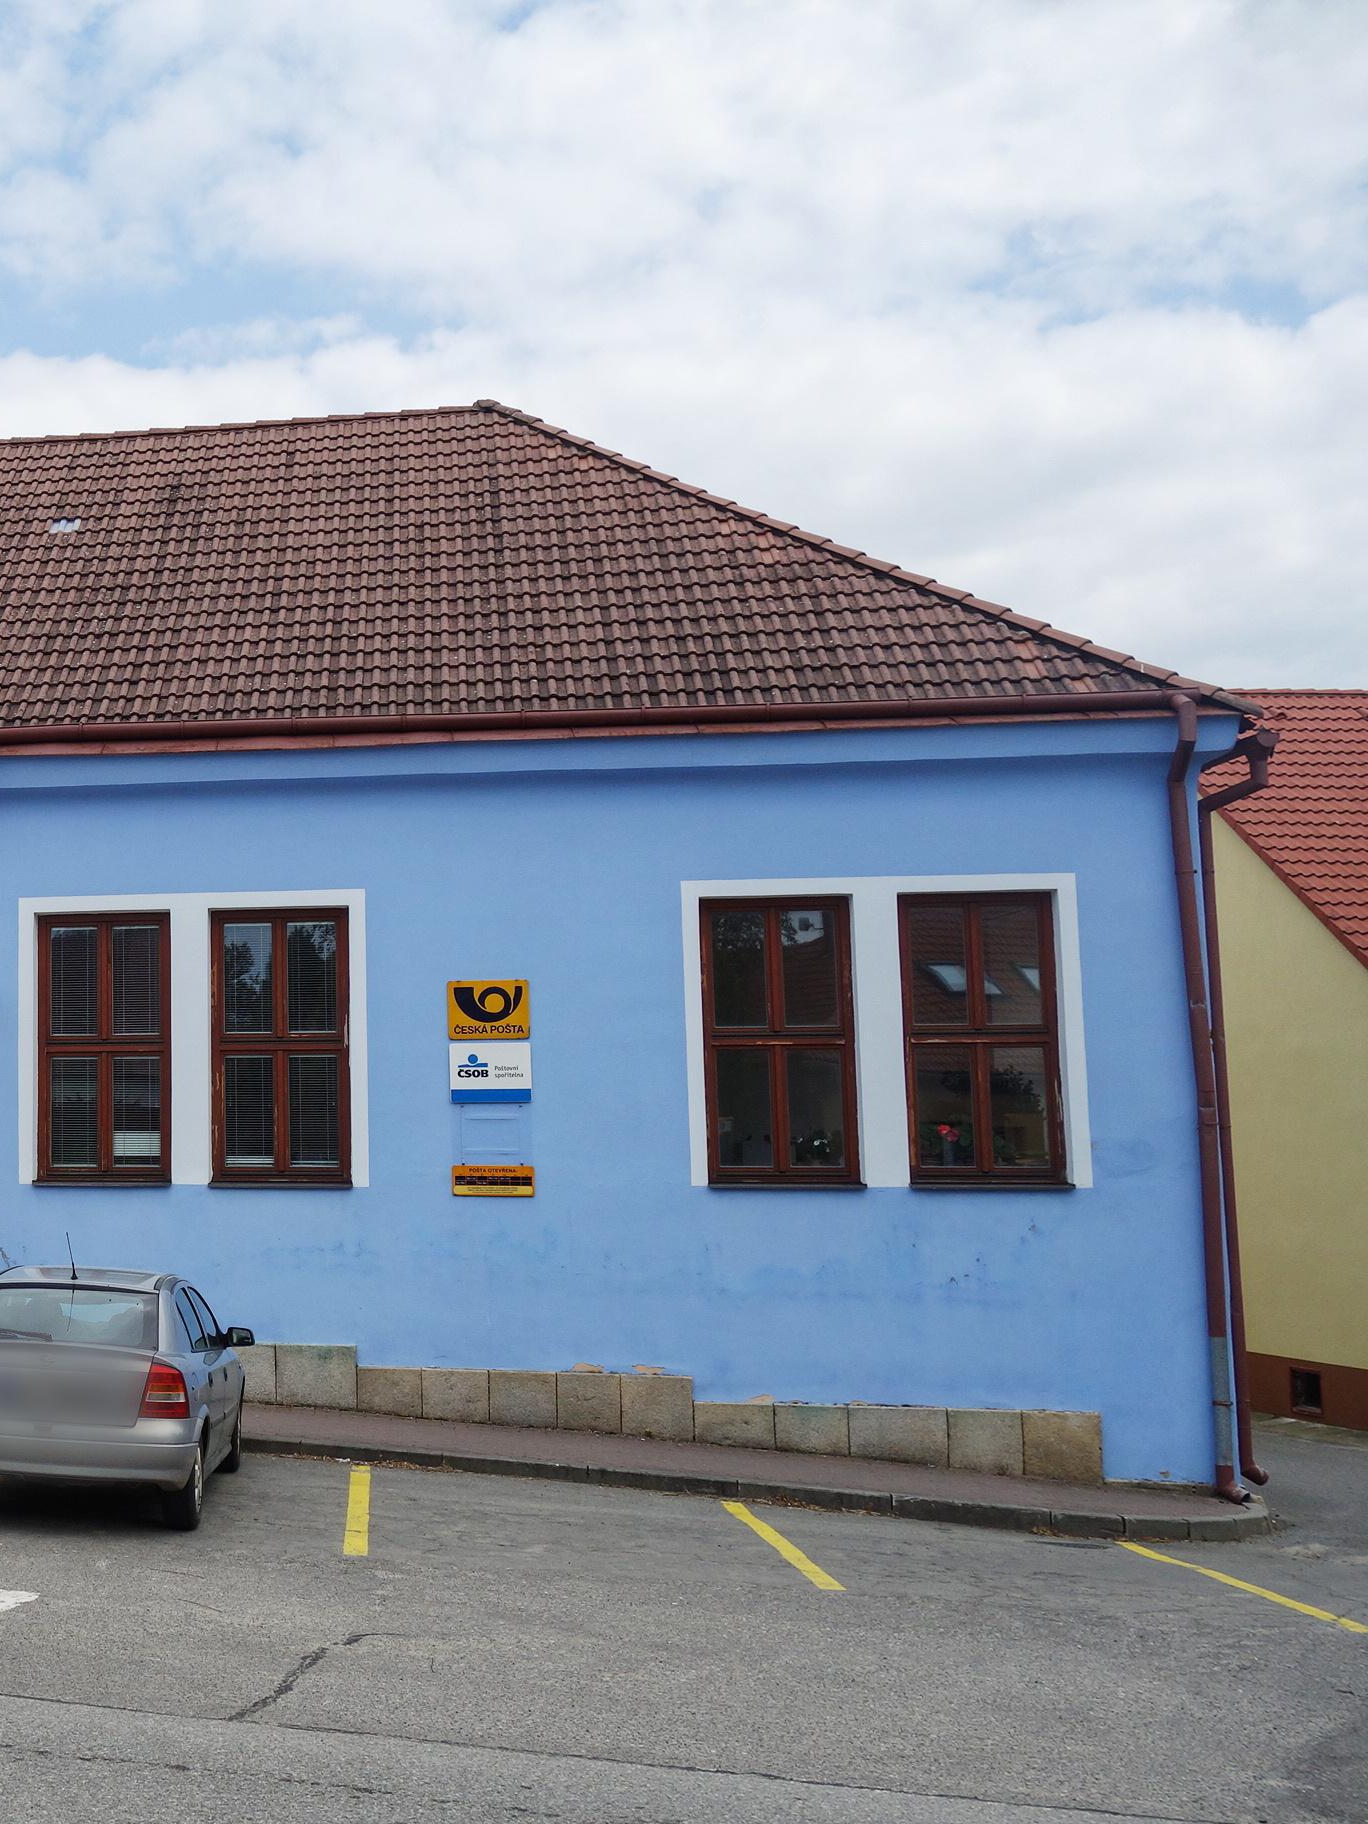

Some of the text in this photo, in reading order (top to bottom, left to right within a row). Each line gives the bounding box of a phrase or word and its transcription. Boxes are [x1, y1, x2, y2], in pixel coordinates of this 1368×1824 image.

[453, 1024, 525, 1035] ČESKÁ POŠTA
[457, 1068, 489, 1078] ČSOB
